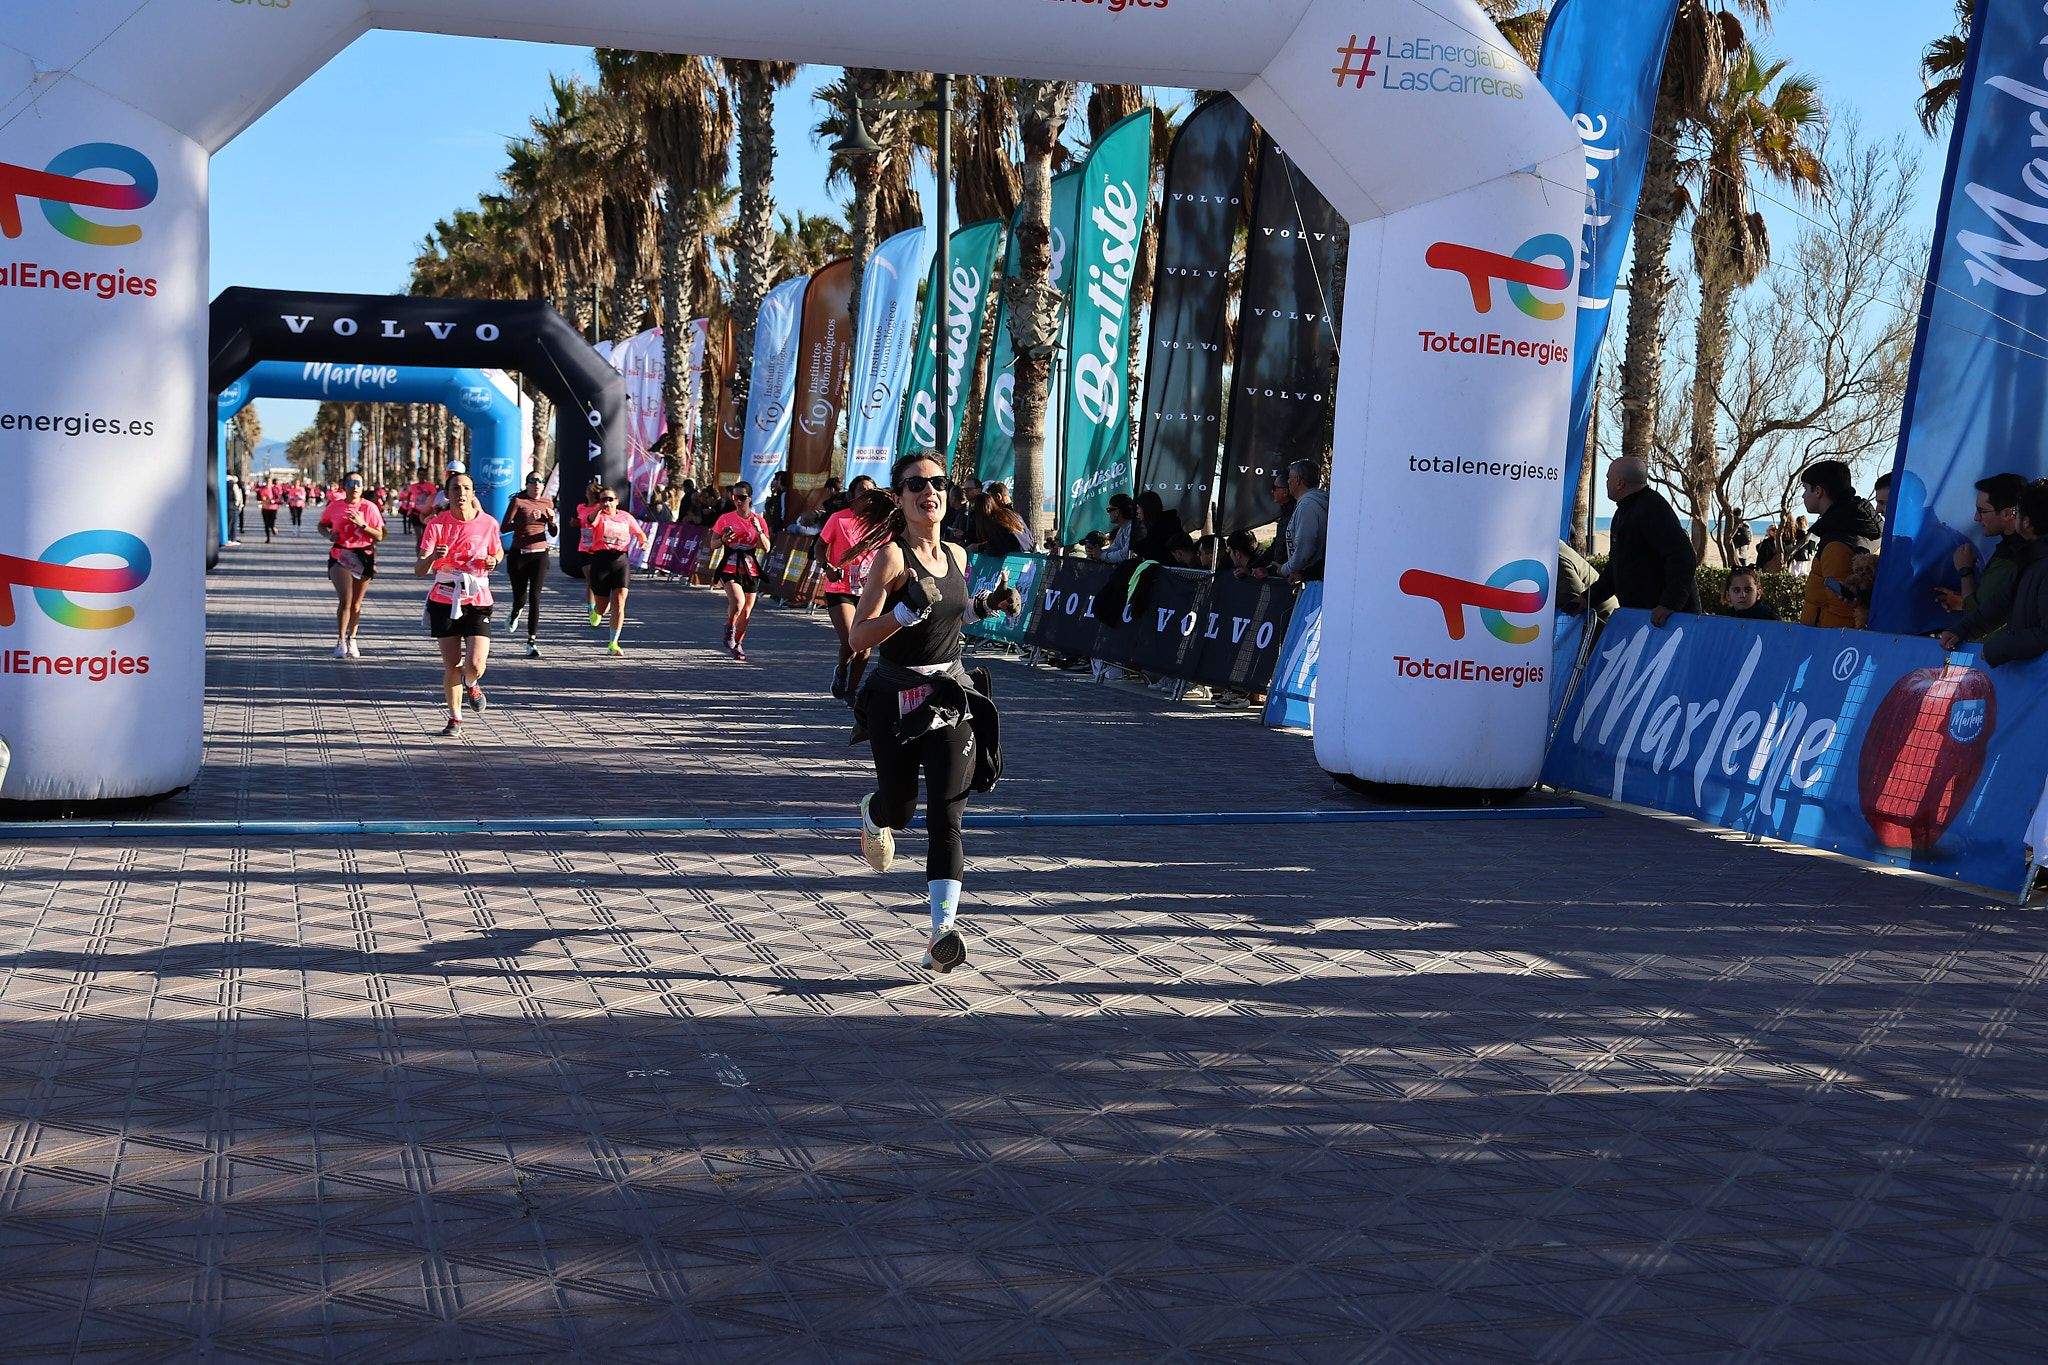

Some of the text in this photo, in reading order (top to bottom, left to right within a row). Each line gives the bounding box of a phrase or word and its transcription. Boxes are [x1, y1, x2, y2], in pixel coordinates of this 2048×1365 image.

[1383, 65, 1525, 100] LasCarreras
[1172, 193, 1239, 205] VOLVO
[1075, 179, 1137, 429] Batiste
[1254, 308, 1331, 322] VOLVO
[281, 315, 500, 341] VOLVO
[819, 318, 836, 395] Odontológicos
[869, 325, 883, 377] Institutos
[910, 266, 981, 448] Batiste
[1161, 340, 1217, 351] VOLVO
[1418, 331, 1568, 365] TotalEnergies
[302, 362, 397, 395] Marlene
[808, 342, 822, 394] Institutos
[1246, 387, 1322, 402] VOLVO
[1154, 412, 1215, 422] VOLVO
[1409, 455, 1558, 481] totalenergies.es
[1144, 482, 1207, 492] VOLVO
[1157, 607, 1274, 649] VOLVO
[0, 649, 149, 682] lEnergies
[1393, 655, 1543, 688] TotalEnergies
[1573, 625, 1837, 815] Marlene
[962, 741, 973, 757] FILA
